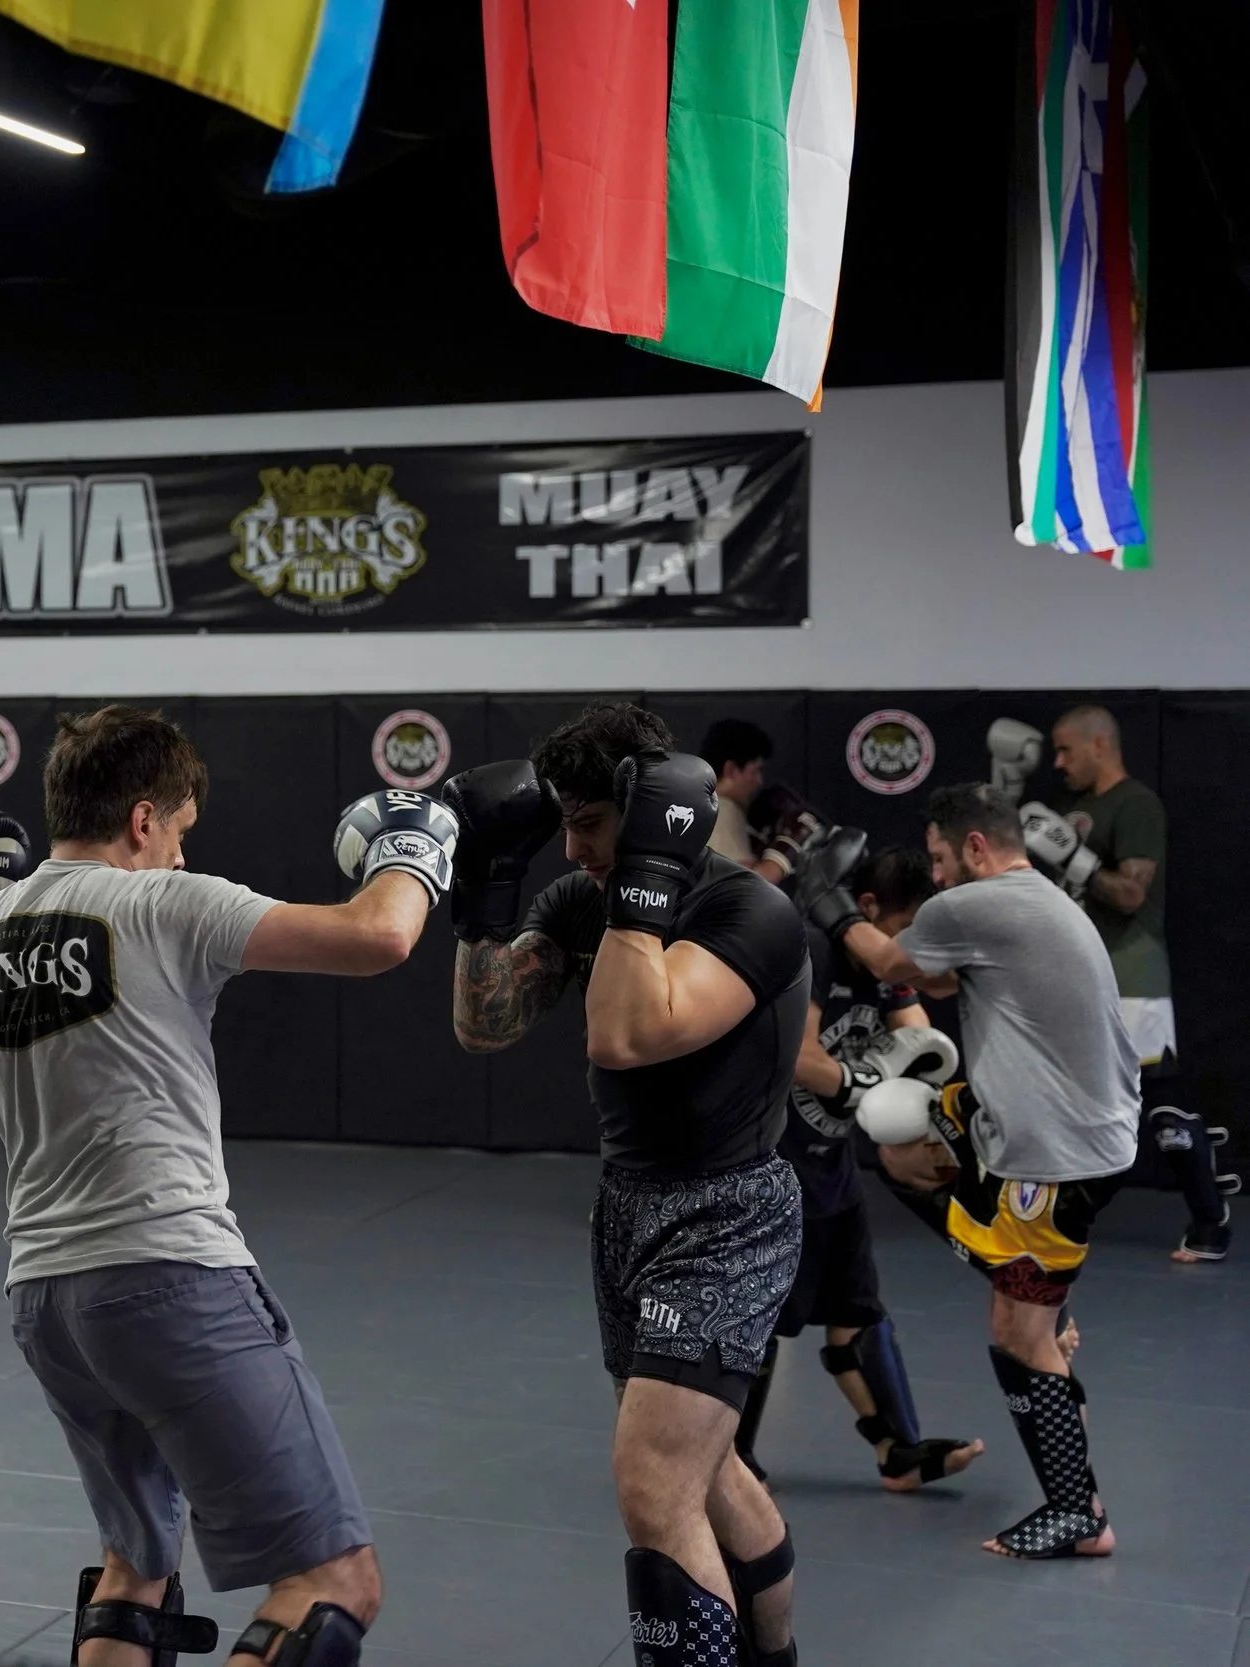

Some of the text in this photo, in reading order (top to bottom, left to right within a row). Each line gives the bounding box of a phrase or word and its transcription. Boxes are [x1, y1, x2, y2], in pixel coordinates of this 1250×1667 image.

[498, 465, 749, 525] MUAY
[244, 512, 417, 570] KINGS
[515, 541, 723, 598] THAI
[619, 885, 669, 909] VENUM
